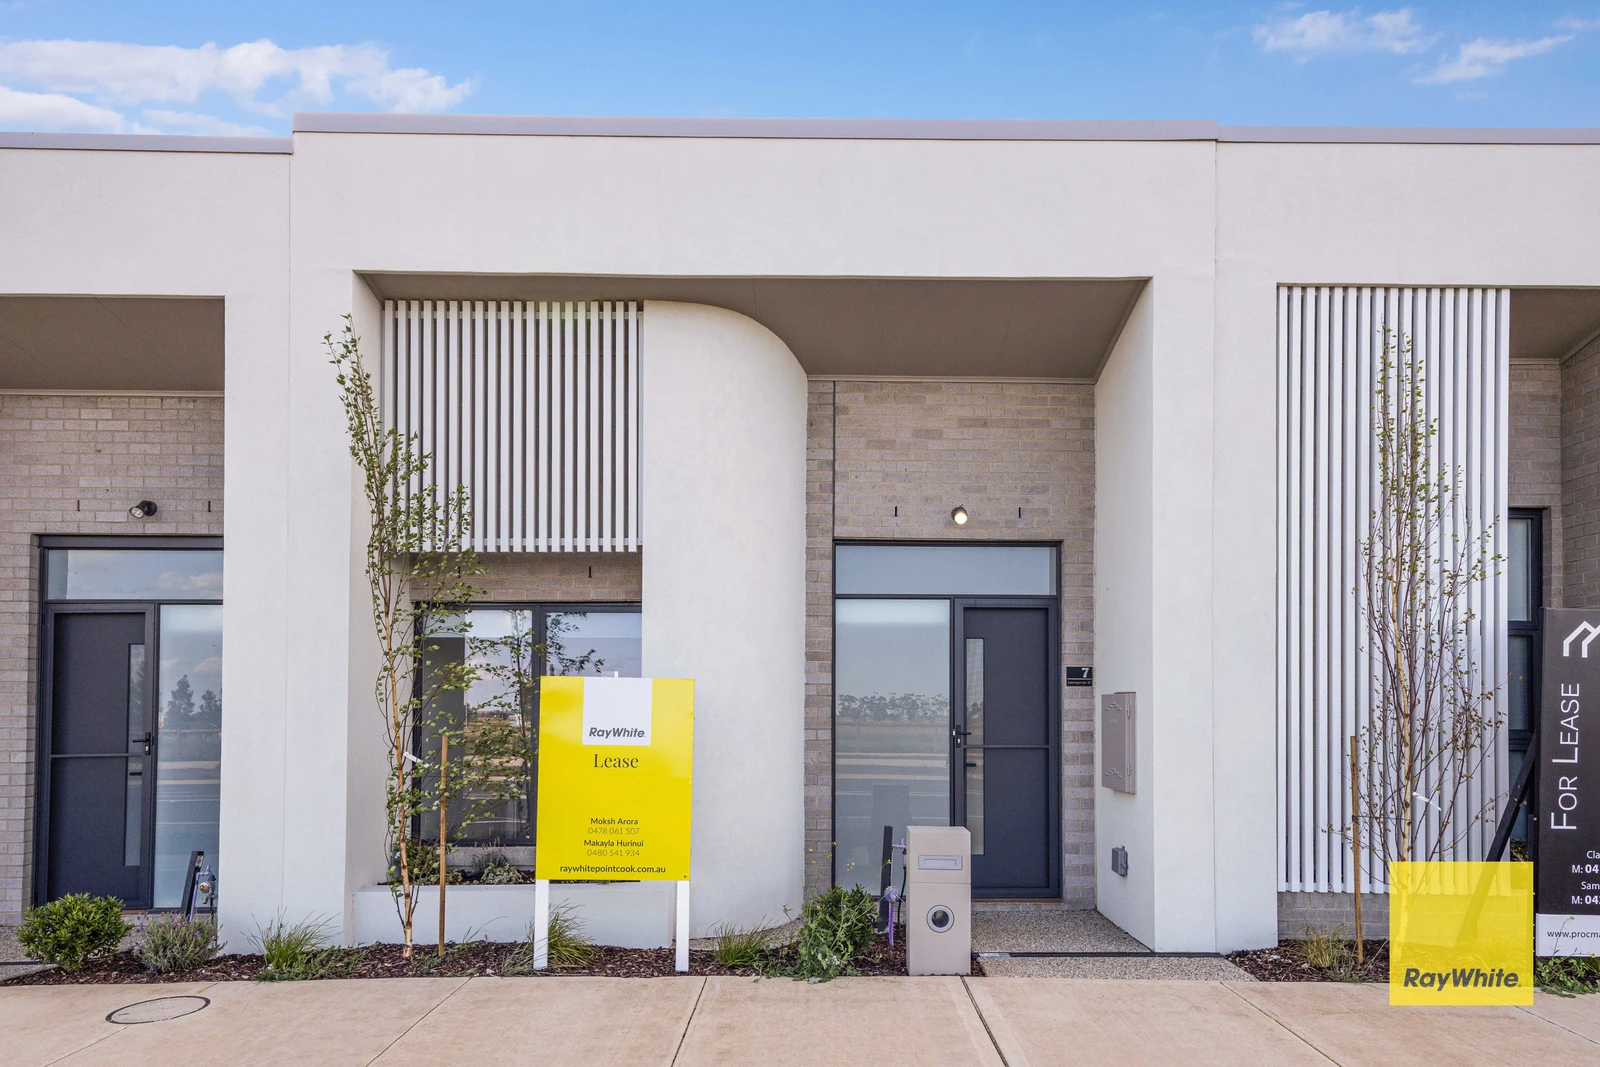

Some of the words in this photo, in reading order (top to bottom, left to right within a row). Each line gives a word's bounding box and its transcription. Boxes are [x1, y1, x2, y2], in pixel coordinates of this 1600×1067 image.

[1081, 667, 1090, 678] 7
[1551, 683, 1580, 764] LEASE
[593, 753, 639, 769] Lease
[1550, 776, 1578, 830] FOR
[588, 827, 608, 835] 0478
[609, 827, 623, 835] 061
[625, 827, 640, 835] 507
[583, 840, 615, 848] Makayla
[586, 849, 608, 857] 0480
[609, 849, 623, 857] 541
[625, 849, 640, 857] 934
[560, 865, 666, 873] raywhitepointcook.com.au
[1571, 864, 1583, 873] M:
[1571, 895, 1583, 904] M:
[1584, 895, 1600, 905] 04
